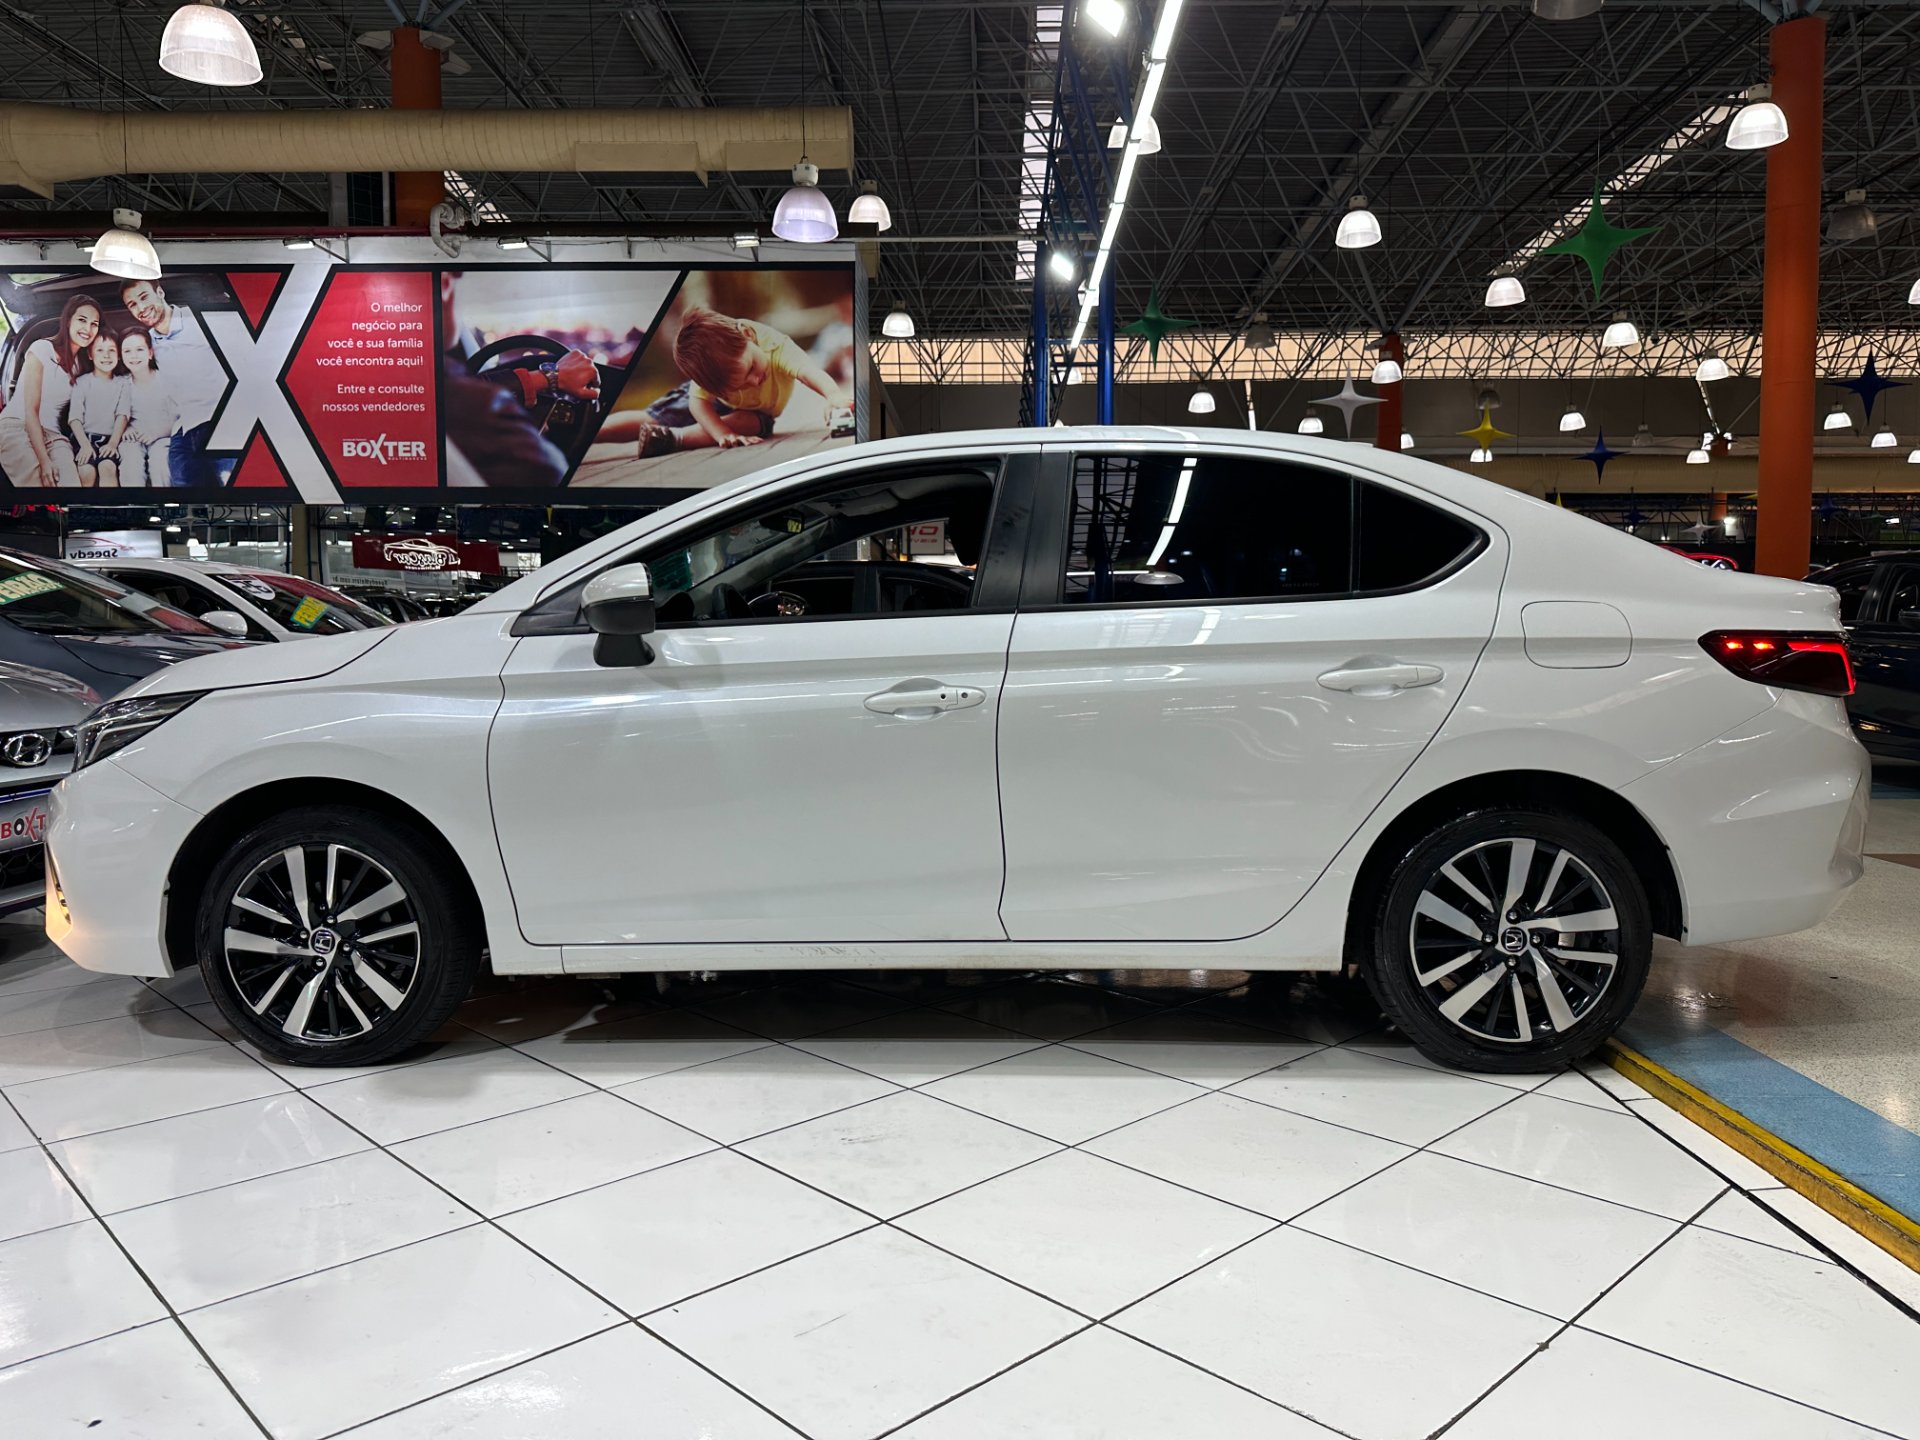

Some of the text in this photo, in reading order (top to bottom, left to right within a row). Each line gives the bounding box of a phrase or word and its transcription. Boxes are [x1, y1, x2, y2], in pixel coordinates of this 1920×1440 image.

[371, 302, 422, 312] O melhor
[352, 319, 423, 332] negócio para
[328, 338, 354, 348] você
[387, 337, 423, 348] família
[316, 356, 424, 367] você encontra aqui!
[337, 384, 424, 394] Entre e consulte
[362, 401, 425, 411] vendedores
[342, 433, 426, 464] BOXTER
[0, 807, 46, 841] BOXT
